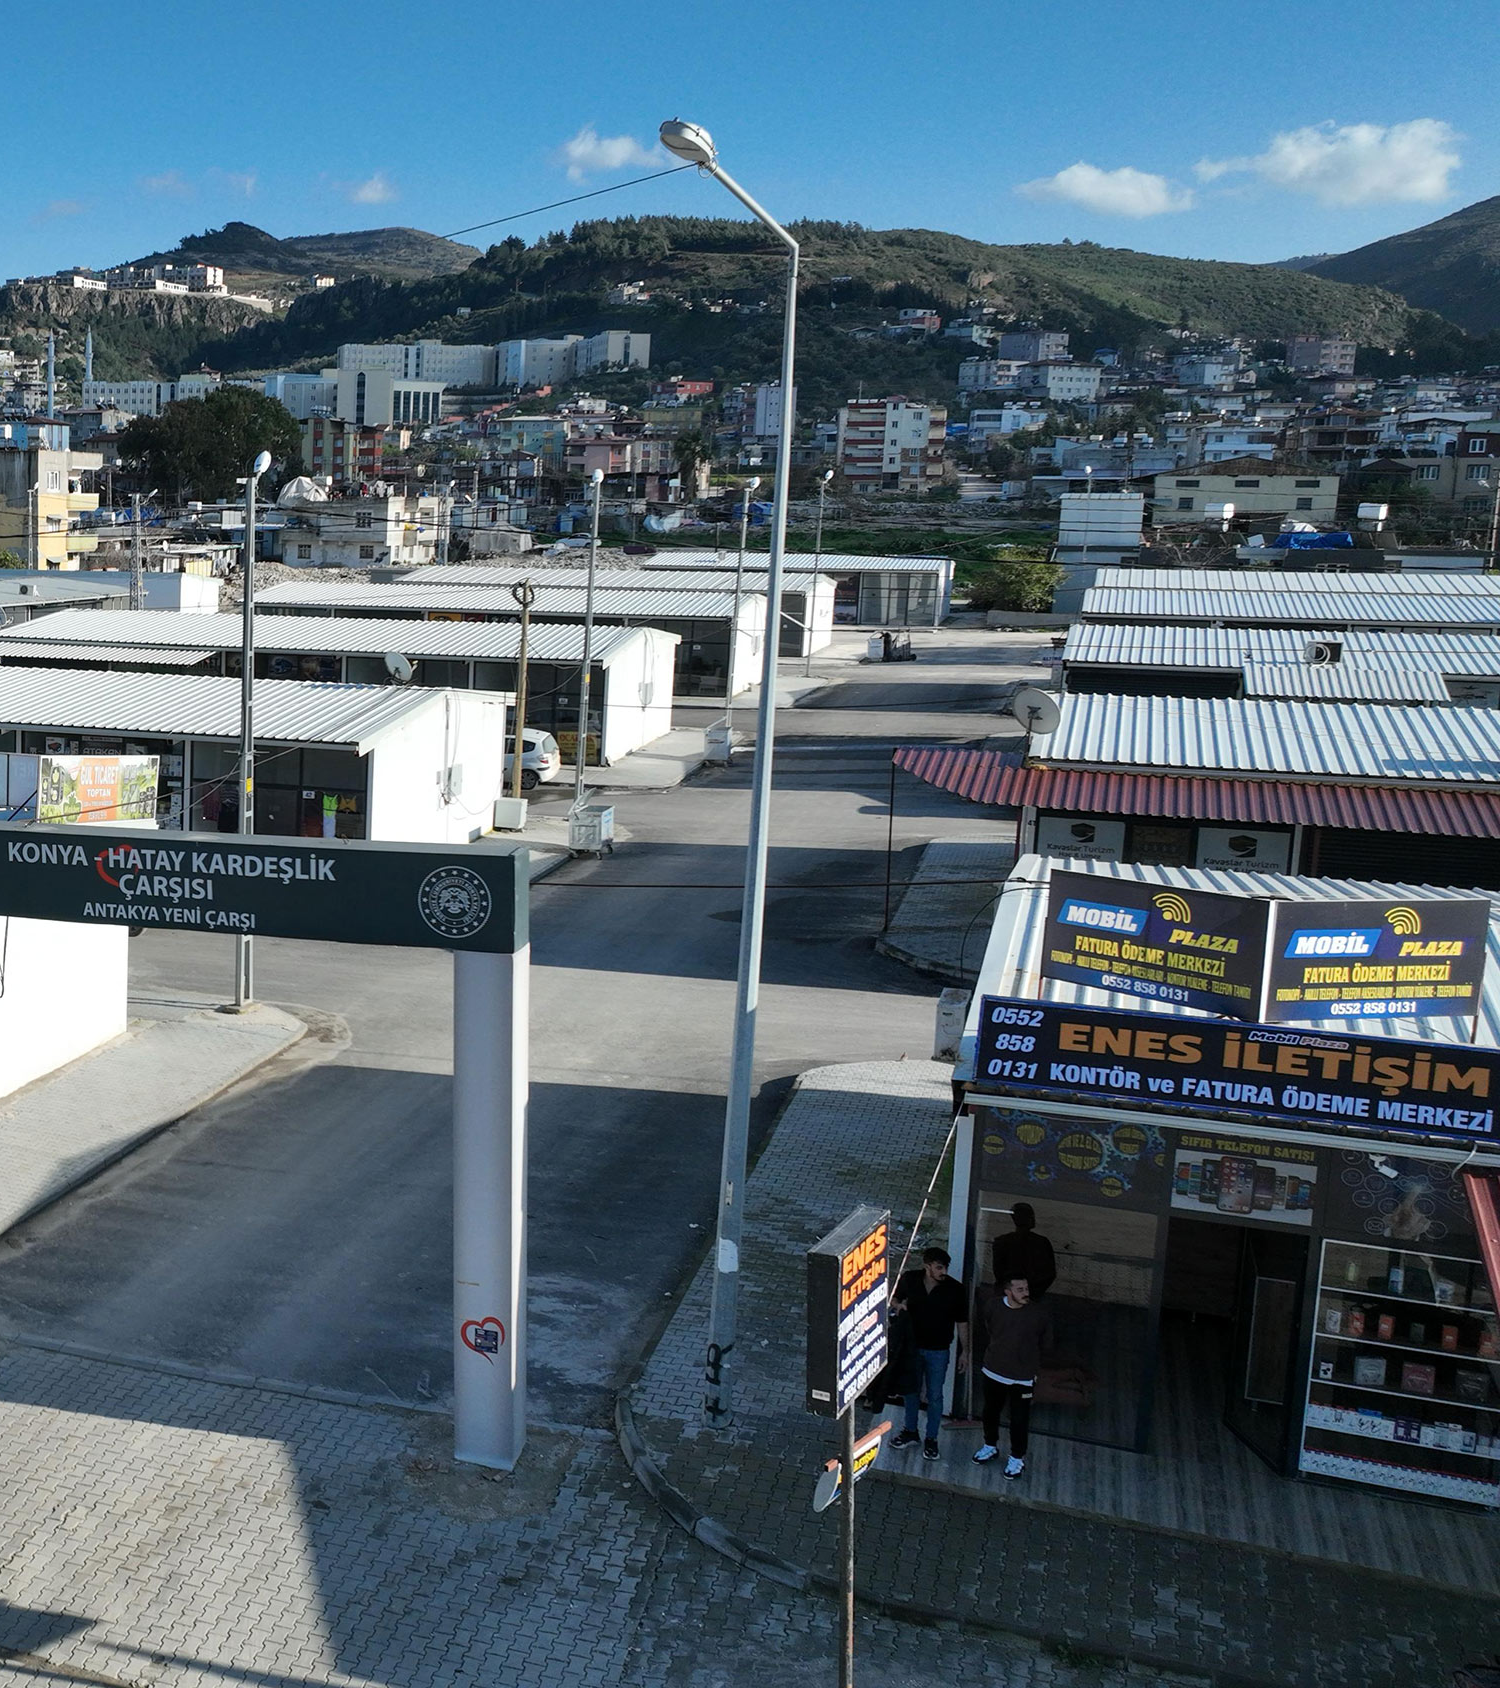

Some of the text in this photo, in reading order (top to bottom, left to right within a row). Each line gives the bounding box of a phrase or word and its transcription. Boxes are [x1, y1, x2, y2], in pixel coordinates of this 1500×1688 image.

[87, 788, 111, 798] TOPTAN
[1047, 842, 1115, 854] Kavaslar Turizm
[8, 841, 89, 866] KONYA
[108, 848, 188, 872] HATAY
[191, 852, 336, 885] KARDEŞLİK
[1203, 857, 1279, 869] Kavaslar Turizm
[119, 873, 214, 903] ÇARŞISI
[83, 902, 256, 932] ANTAKYA YENİ ÇARŞI
[1066, 905, 1138, 932] MOBİL
[1168, 928, 1239, 954] PLAZA
[1295, 931, 1369, 956] MOBİL
[1398, 941, 1463, 957] PLAZA
[1075, 936, 1226, 977] FATURA ÖDEME MERKEZİ
[1303, 960, 1451, 984] FATURA ÖDEME MERKEZİ
[1101, 975, 1189, 1001] 0552 858 0131
[991, 1006, 1044, 1028] 0552
[1330, 1001, 1417, 1015] 0552 858 0131
[995, 1033, 1036, 1053] 858
[1248, 1030, 1350, 1050] Mobil Plaza
[987, 1059, 1039, 1079] 0131
[1058, 1022, 1491, 1098] ENES İLETİŞİM
[1050, 1062, 1494, 1133] KONTÖR ve FATURA ÖDEME MERKEZİ
[1181, 1135, 1315, 1161] SIFIR TELEFON SATIŞI
[841, 1224, 887, 1286] ENES
[841, 1257, 886, 1311] İLETİŞİM
